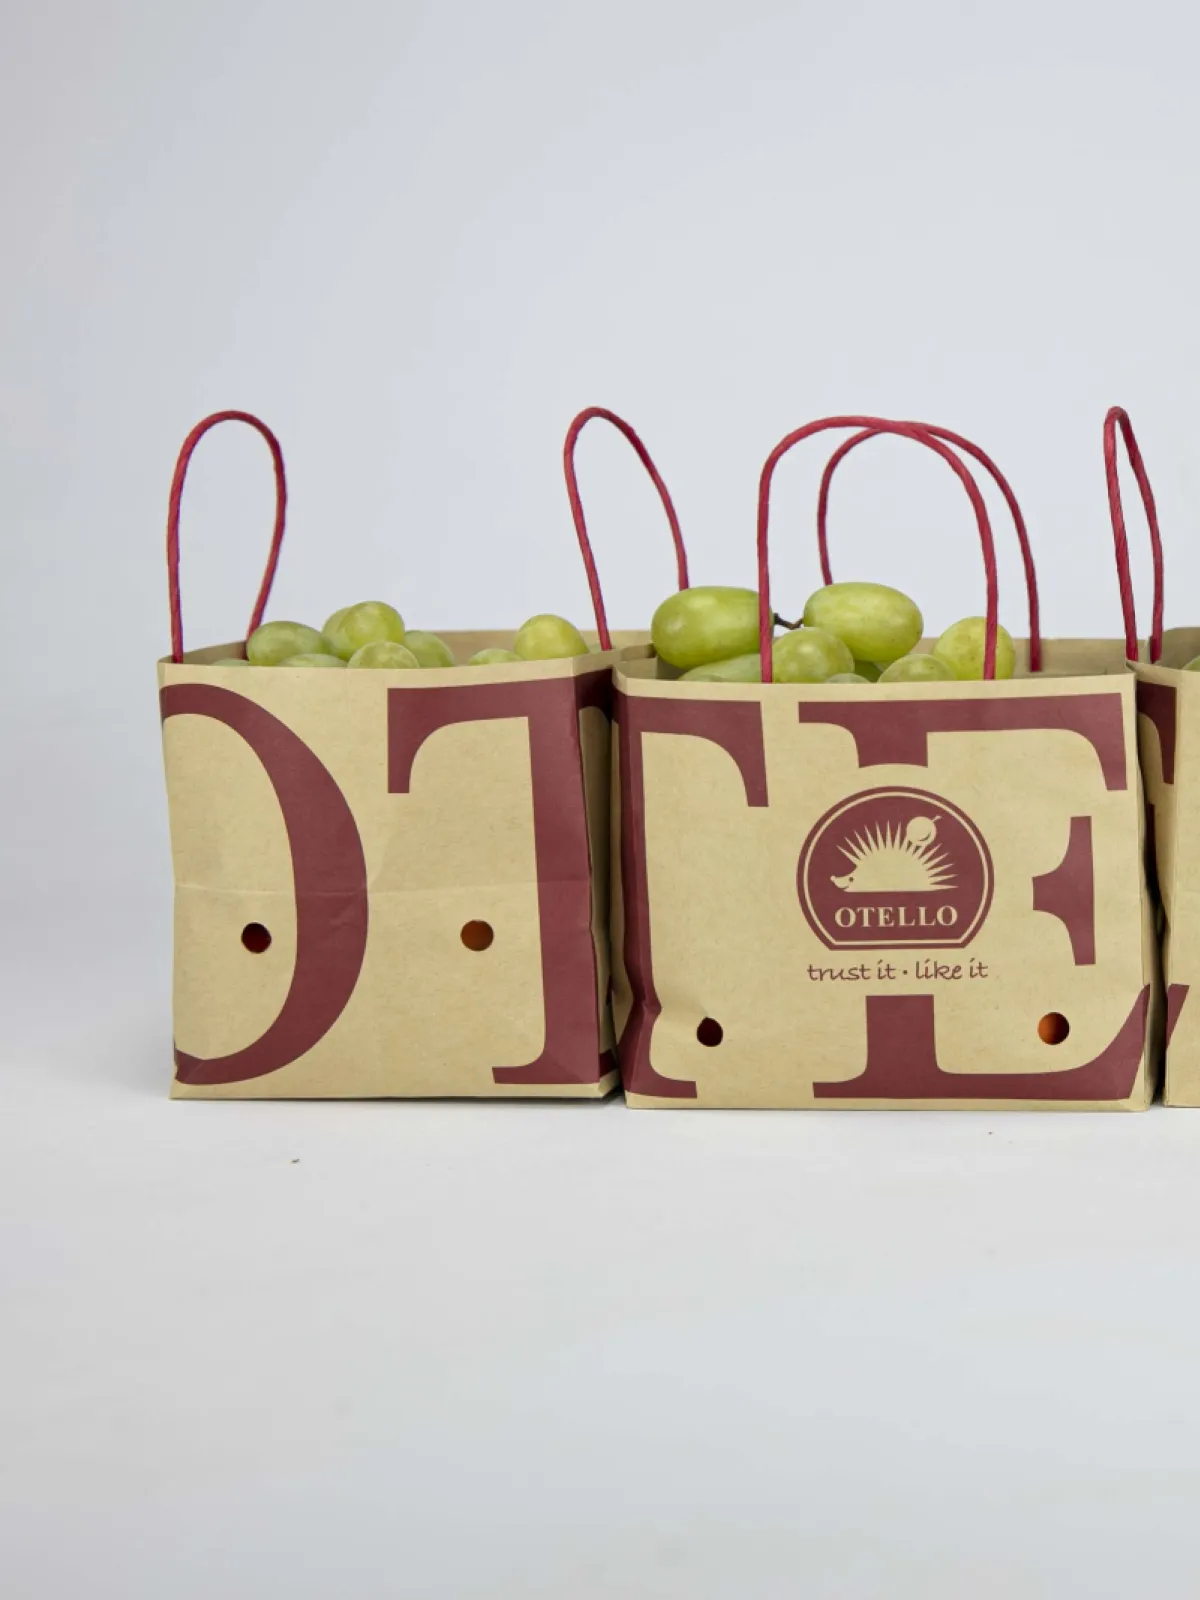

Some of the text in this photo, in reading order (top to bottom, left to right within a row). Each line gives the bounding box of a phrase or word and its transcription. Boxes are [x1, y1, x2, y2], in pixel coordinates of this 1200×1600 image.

[834, 905, 958, 928] OTELLO
[806, 963, 871, 981] trust
[876, 959, 896, 980] it
[915, 958, 963, 980] like
[969, 957, 989, 979] it
